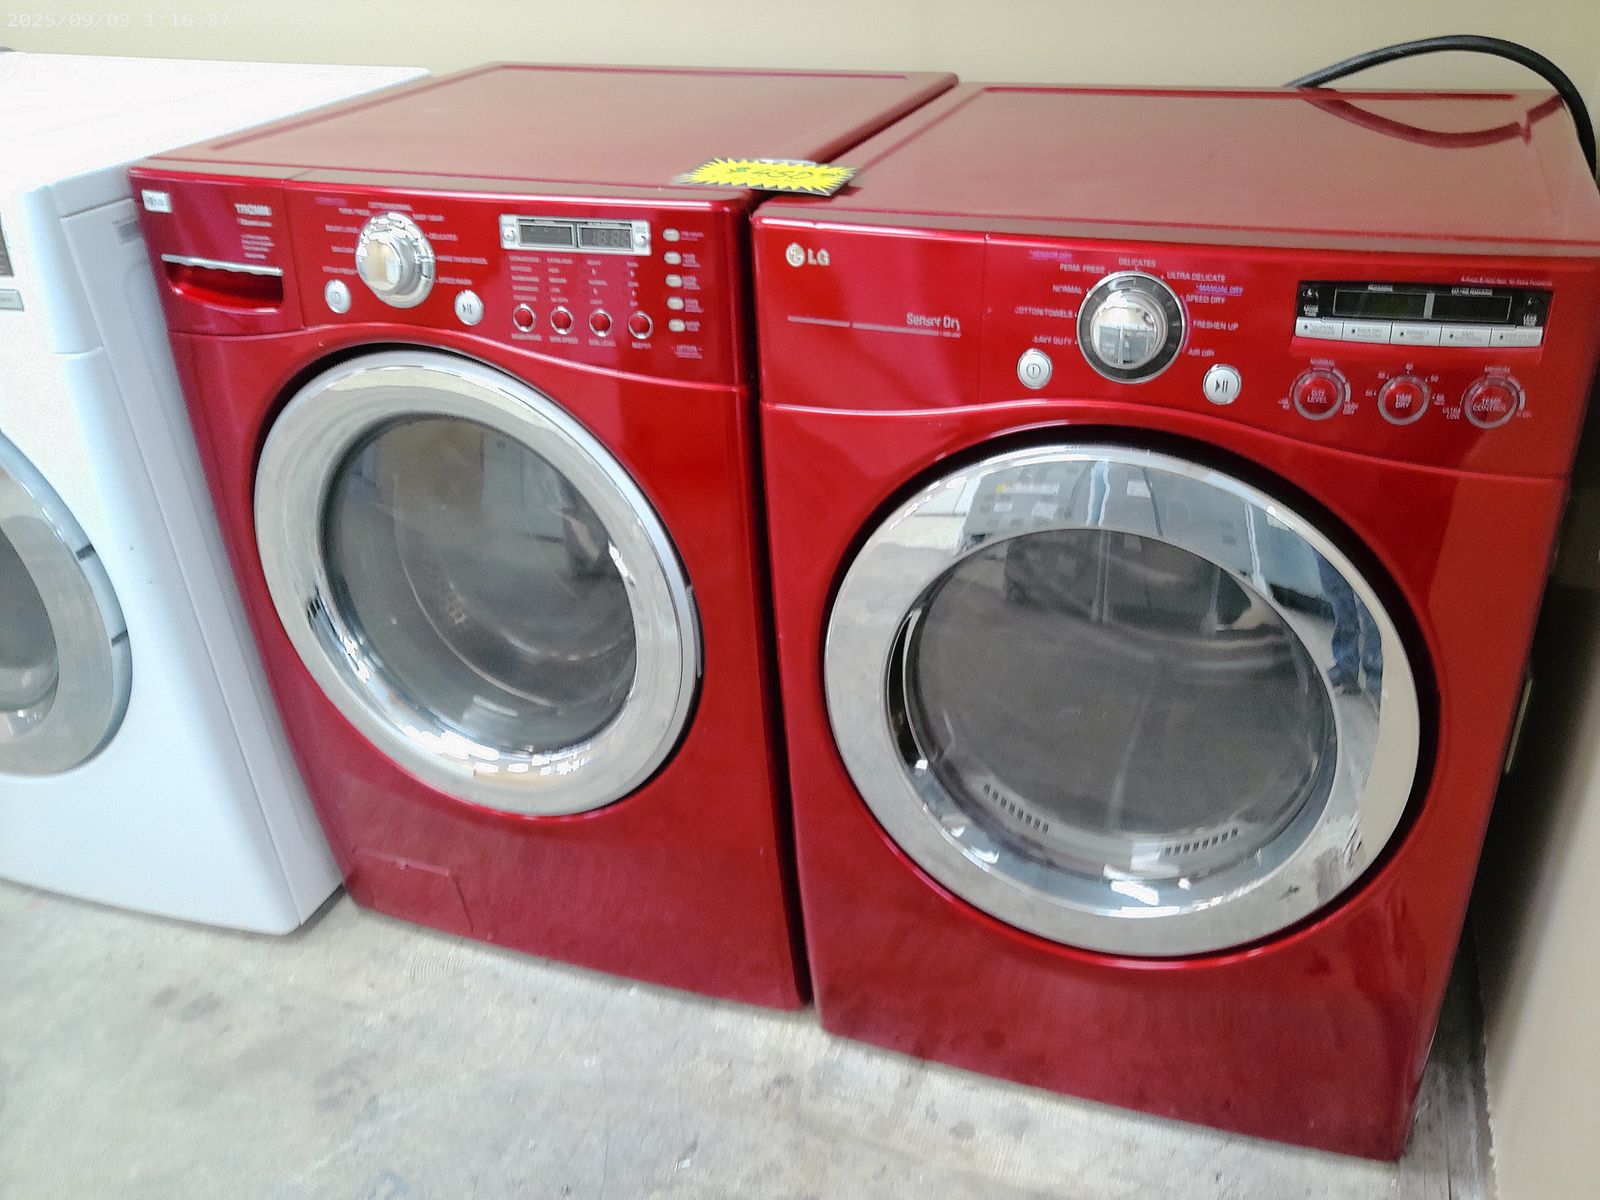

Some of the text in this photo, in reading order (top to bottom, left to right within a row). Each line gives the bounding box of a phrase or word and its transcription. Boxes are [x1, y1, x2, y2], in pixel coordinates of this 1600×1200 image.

[807, 248, 830, 266] LG
[1118, 257, 1157, 269] DELICATES
[1192, 272, 1226, 283] DELICATE
[906, 311, 961, 332] Sensor Dry
[1192, 319, 1227, 331] FRESHEN
